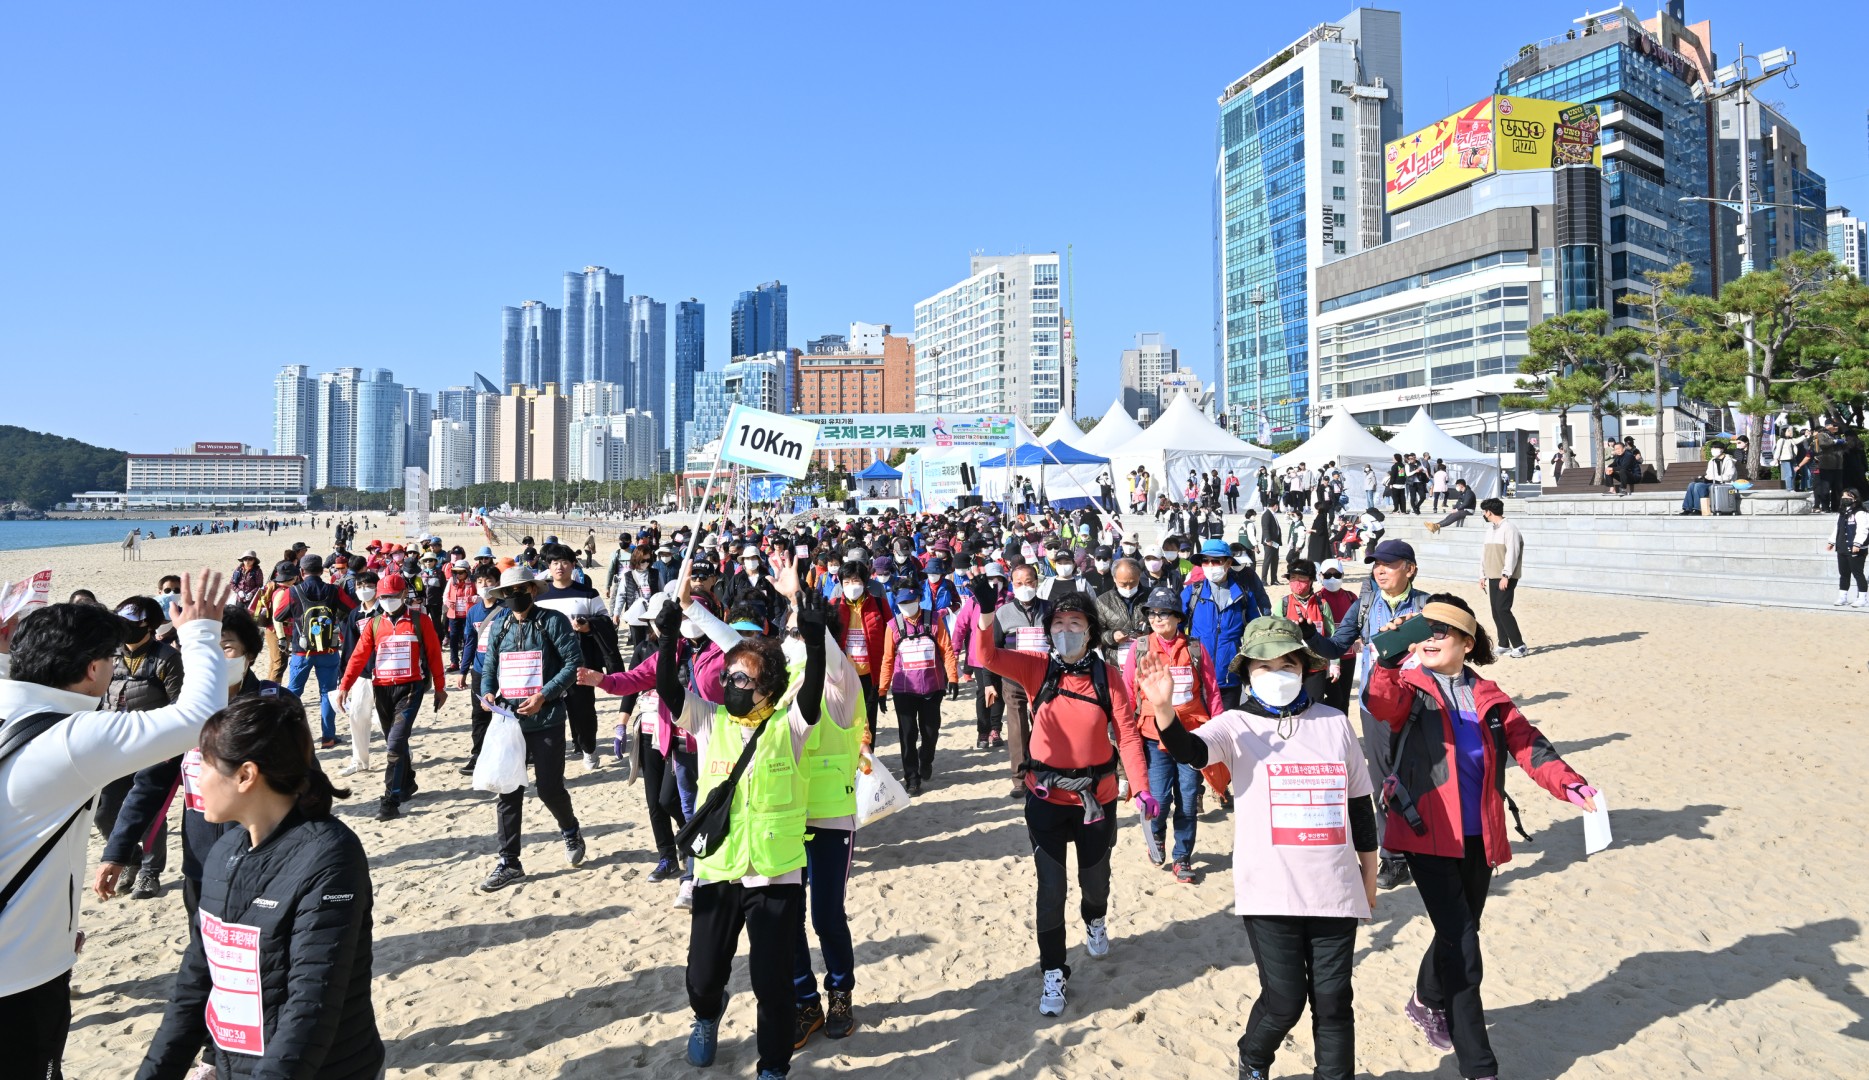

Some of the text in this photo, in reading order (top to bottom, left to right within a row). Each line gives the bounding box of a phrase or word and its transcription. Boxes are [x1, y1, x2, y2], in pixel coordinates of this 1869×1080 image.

[1457, 131, 1490, 153] 진라면
[1512, 139, 1537, 154] PIZZA
[1395, 140, 1445, 193] 진라면
[1322, 208, 1334, 246] HOTEL
[740, 424, 803, 461] 10Km
[823, 425, 926, 440] 국제걷기축제
